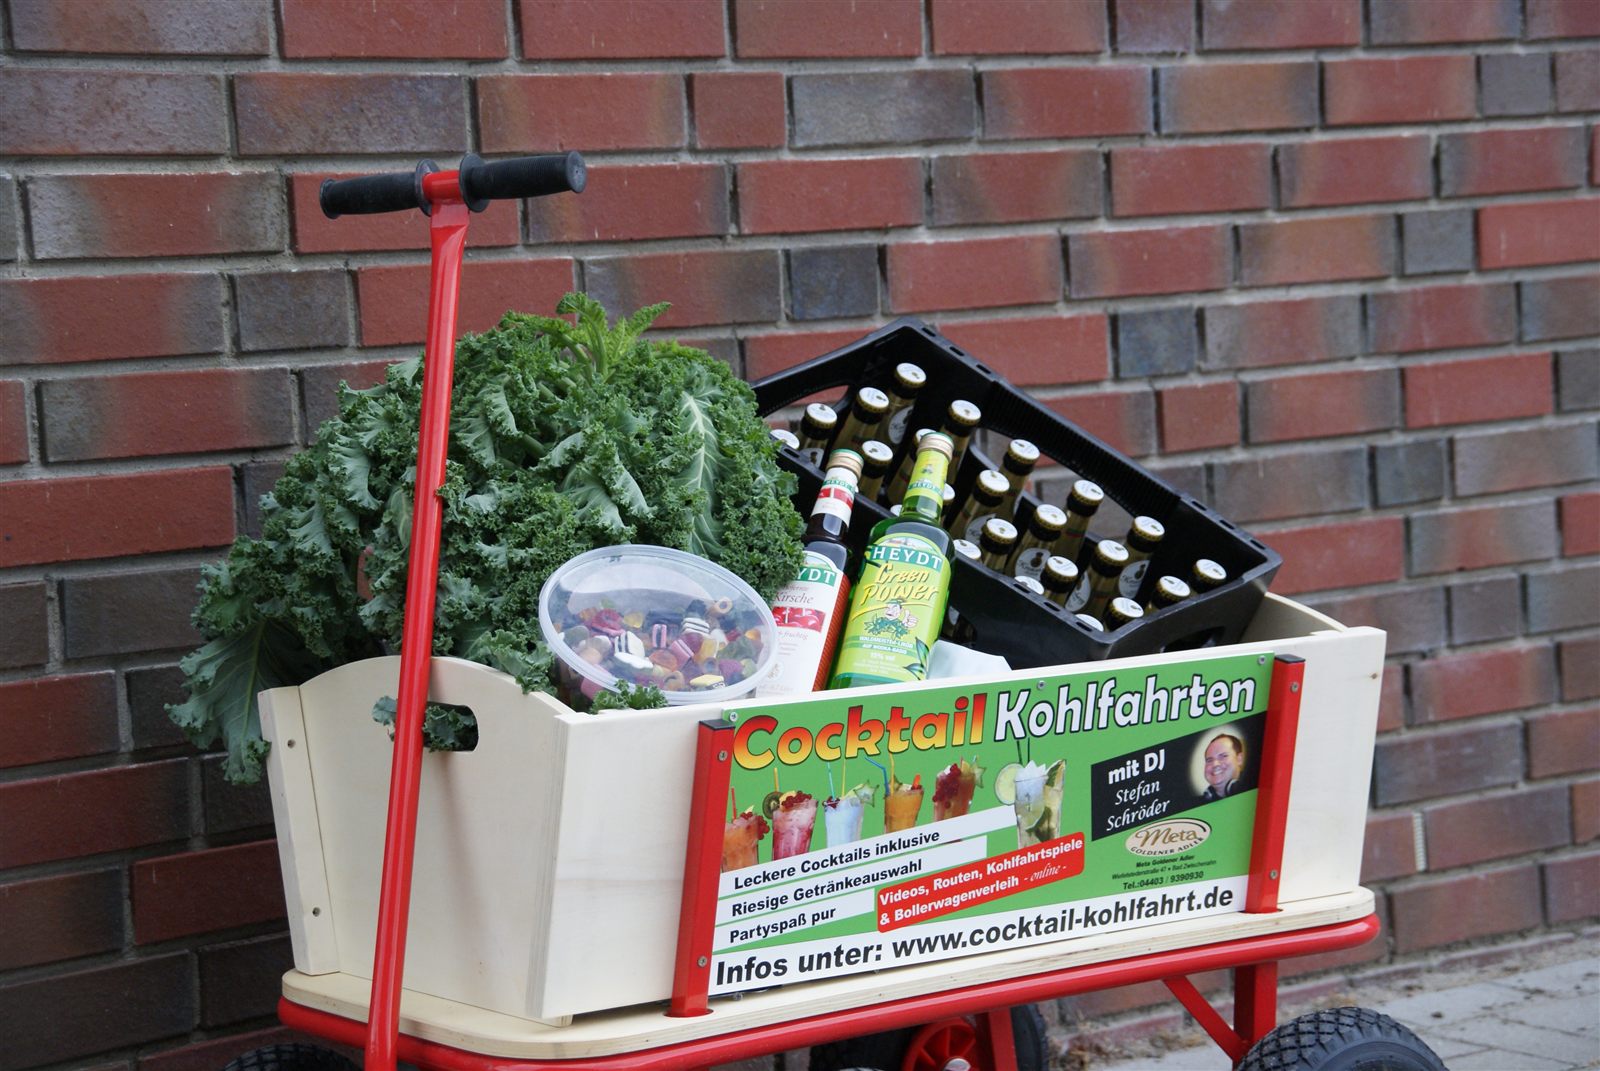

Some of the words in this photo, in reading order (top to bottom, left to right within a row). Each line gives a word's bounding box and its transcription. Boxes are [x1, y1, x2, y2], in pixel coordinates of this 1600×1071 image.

[872, 546, 942, 569] HEYDT
[875, 563, 930, 584] Green
[799, 568, 836, 585] YDT
[775, 591, 814, 604] Kirsche
[733, 693, 987, 770] Cocktail
[994, 674, 1256, 742] Kohlfahrten
[1108, 759, 1140, 784] mit
[1143, 749, 1166, 774] DJ
[1115, 780, 1161, 805] Stefan
[1106, 799, 1170, 832] Schröder
[1131, 846, 1175, 855] GOLDENER
[1178, 837, 1203, 852] ADLER
[1135, 827, 1198, 847] Meta
[734, 867, 796, 890] Leckere
[800, 848, 871, 873] Cocktails
[875, 831, 940, 856] inklusive
[879, 885, 929, 906] Videos,
[933, 868, 983, 890] Routen,
[986, 838, 1083, 875] Kohlfahrtspiele
[1152, 857, 1178, 866] Goldener
[732, 890, 788, 917] Riesige
[793, 859, 922, 901] Getränkeauswahl
[879, 914, 890, 926] &
[894, 876, 1019, 922] Bollerwagenverleih
[716, 956, 788, 985] Infos
[798, 943, 883, 972] unter:
[892, 885, 1234, 958] www.cocktail-kohlfahrt.de
[730, 914, 807, 943] Partyspaß
[811, 907, 836, 926] pur
